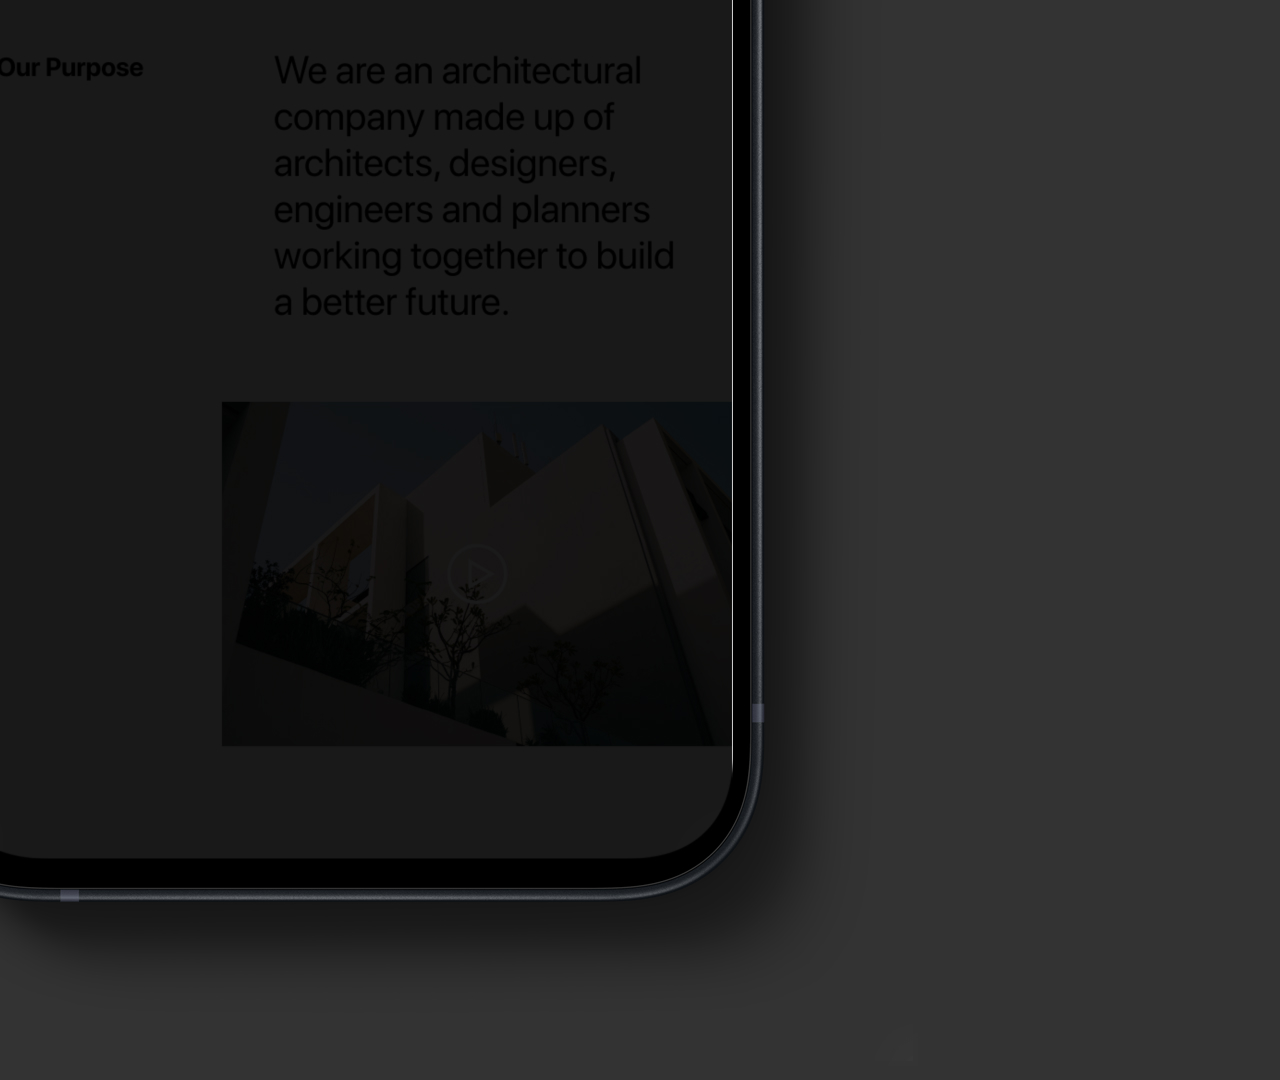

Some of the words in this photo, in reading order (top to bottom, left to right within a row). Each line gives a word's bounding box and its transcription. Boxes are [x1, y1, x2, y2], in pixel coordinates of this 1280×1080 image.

[46, 56, 144, 82] Purpose
[274, 55, 327, 85] We
[335, 62, 386, 85] are
[394, 62, 433, 85] an
[442, 55, 641, 85] architectural
[274, 108, 426, 138] company
[434, 101, 525, 131] made
[534, 108, 575, 137] up
[583, 101, 615, 131] of
[274, 147, 441, 183] architects,
[449, 147, 616, 185] designers,
[274, 194, 434, 231] engineers
[442, 193, 502, 224] and
[512, 194, 651, 230] planners
[273, 240, 402, 277] working
[410, 240, 549, 277] together
[555, 243, 588, 270] to
[597, 240, 674, 270] build
[274, 293, 292, 316] a
[302, 286, 398, 316] better
[405, 286, 509, 316] future.
